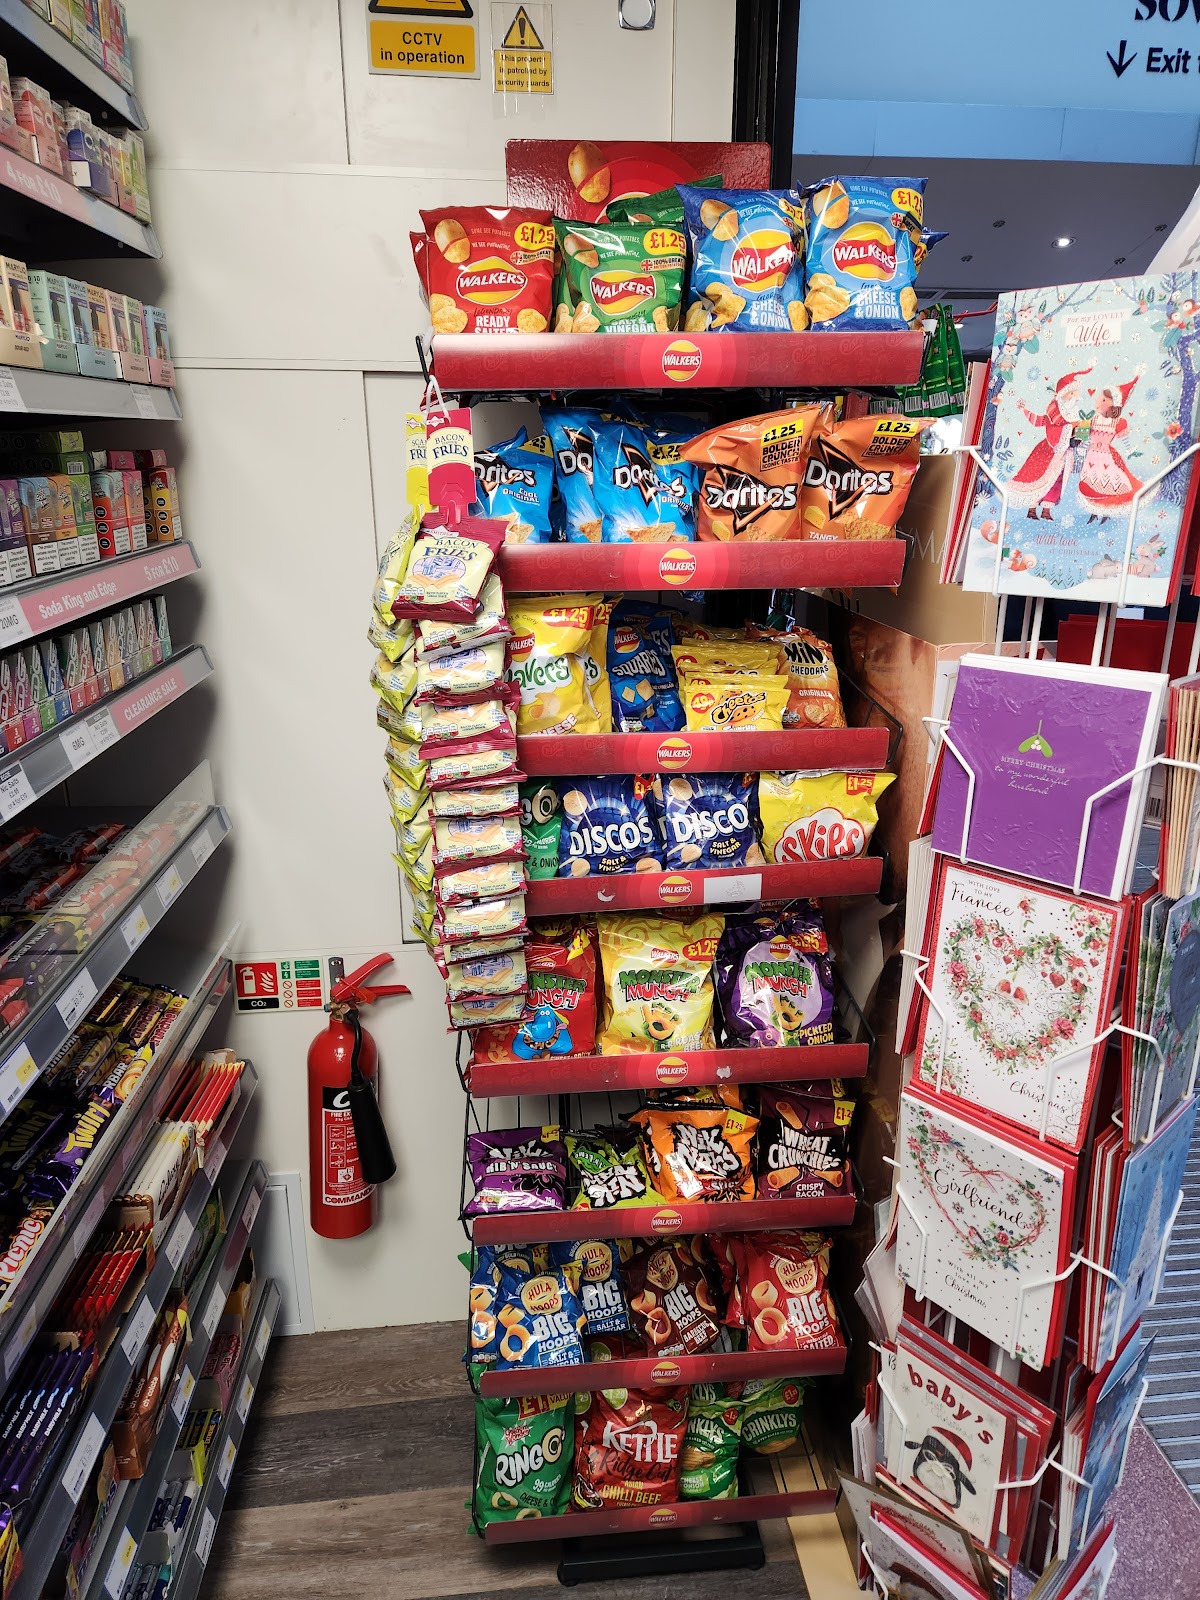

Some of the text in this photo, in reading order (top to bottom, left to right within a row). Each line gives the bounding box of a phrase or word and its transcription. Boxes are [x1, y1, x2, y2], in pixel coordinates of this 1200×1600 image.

[402, 31, 442, 46] CCTV
[380, 48, 465, 64] in operation
[516, 55, 546, 64] property
[1146, 47, 1191, 74] Exit
[507, 67, 536, 75] patrolled
[498, 79, 550, 88] security guards
[521, 227, 554, 245] £1.25
[650, 232, 686, 249] £1.25
[732, 250, 796, 277] WALKER
[835, 245, 896, 269] WALKERS
[459, 272, 526, 288] WALKERS
[592, 276, 654, 299] WALKERS
[857, 289, 896, 306] CHEESE
[752, 299, 785, 316] CHEESE
[865, 306, 899, 320] ONION
[476, 315, 510, 328] READY
[759, 312, 790, 328] ONION
[1093, 311, 1124, 321] LOVELY
[605, 323, 655, 333] VINEGAR
[1074, 321, 1111, 347] Wife
[664, 354, 700, 366] WALKERS
[764, 423, 798, 442] £1.25
[877, 422, 911, 433] £1.25
[435, 433, 465, 444] BACON
[871, 436, 910, 446] BOLDER
[433, 444, 469, 460] FRIES
[652, 444, 682, 461] £1.25
[763, 439, 800, 455] BOLDER
[867, 443, 908, 454] CRUNCH
[762, 448, 799, 464] CRUNCH
[762, 456, 799, 470] ICONIC TASTE
[613, 466, 687, 498] Doritos
[805, 457, 891, 493] Doritos
[502, 488, 540, 503] ORIGINAL
[519, 487, 538, 498] COOL
[706, 483, 797, 511] Doritos
[809, 531, 839, 540] TANGY
[1034, 533, 1079, 547] With love
[435, 539, 477, 549] BACON
[423, 546, 478, 562] FRIES
[1058, 549, 1100, 557] CHRISTMAS
[144, 555, 180, 581] 5 FOR £10
[661, 560, 696, 571] WALKERS
[38, 580, 118, 621] Soda King and Edge
[522, 614, 539, 626] Curly
[550, 606, 588, 626] £1.25
[508, 636, 535, 651] WALKERS
[614, 633, 639, 646] WALKERS
[612, 650, 666, 678] SQUARES
[790, 664, 829, 676] CHEDDARS
[124, 677, 178, 722] CLEARANCE SALE
[711, 692, 767, 725] Cheetos
[72, 735, 87, 751] 6MG
[658, 749, 691, 759] WALKERS
[1000, 755, 1066, 774] MERRY CHRISTMAS
[847, 775, 873, 791] £1.25
[1007, 769, 1070, 788] my wonderful
[1008, 780, 1049, 795] husband
[569, 817, 655, 856] DISCOS
[710, 842, 741, 856] VINEGAR
[712, 841, 729, 849] SALT
[601, 857, 620, 866] SALT
[659, 885, 691, 895] WALKERS
[968, 879, 1001, 894] WITH LOVE
[952, 880, 1014, 917] Fiancée
[688, 941, 718, 956] £1.25
[770, 943, 792, 952] WALKERS
[651, 950, 680, 962] WALKERS
[619, 968, 700, 993] MONSTER
[745, 961, 813, 986] MONSTER
[626, 983, 691, 1002] MUNCH
[754, 976, 808, 998] MUNCH
[250, 999, 267, 1008] CO2
[808, 1033, 834, 1045] ONION
[658, 1067, 687, 1076] WALKERS
[62, 1101, 111, 1153] Twirl
[725, 1118, 744, 1132] £1.25
[783, 1127, 831, 1154] WHEAT
[768, 1144, 842, 1171] CRUNCHIES
[795, 1190, 825, 1198] BACON
[796, 1182, 824, 1192] CRISPY
[934, 1168, 1025, 1229] Girlfriend
[651, 1218, 682, 1227] WALKERS
[0, 1219, 45, 1280] Picnic
[582, 1246, 606, 1261] HULA
[584, 1261, 611, 1278] HOOPS
[785, 1271, 815, 1289] HOOPS
[528, 1284, 552, 1301] HULA
[582, 1283, 622, 1311] BIG
[944, 1273, 987, 1308] Christmas
[530, 1297, 560, 1313] HOOPS
[664, 1285, 698, 1322] BIG
[785, 1294, 827, 1327] BIG
[587, 1304, 624, 1321] HOOPS
[675, 1308, 703, 1330] HOOPS
[533, 1312, 574, 1342] BIG
[596, 1322, 615, 1332] SALT
[794, 1318, 830, 1338] HOOPS
[538, 1333, 579, 1353] HOOPS
[548, 1353, 569, 1365] SALT
[652, 1369, 680, 1378] WALKERS
[907, 1363, 995, 1445] baby's
[742, 1413, 797, 1442] CRINKLYS
[602, 1420, 679, 1464] KETTLE
[600, 1448, 677, 1483] Ridge Cut
[533, 1478, 544, 1492] 99
[624, 1481, 645, 1491] ASIAN
[519, 1492, 543, 1507] CHEESE
[602, 1484, 662, 1505] CHILLI BEEF
[649, 1516, 677, 1524] WALKERS
